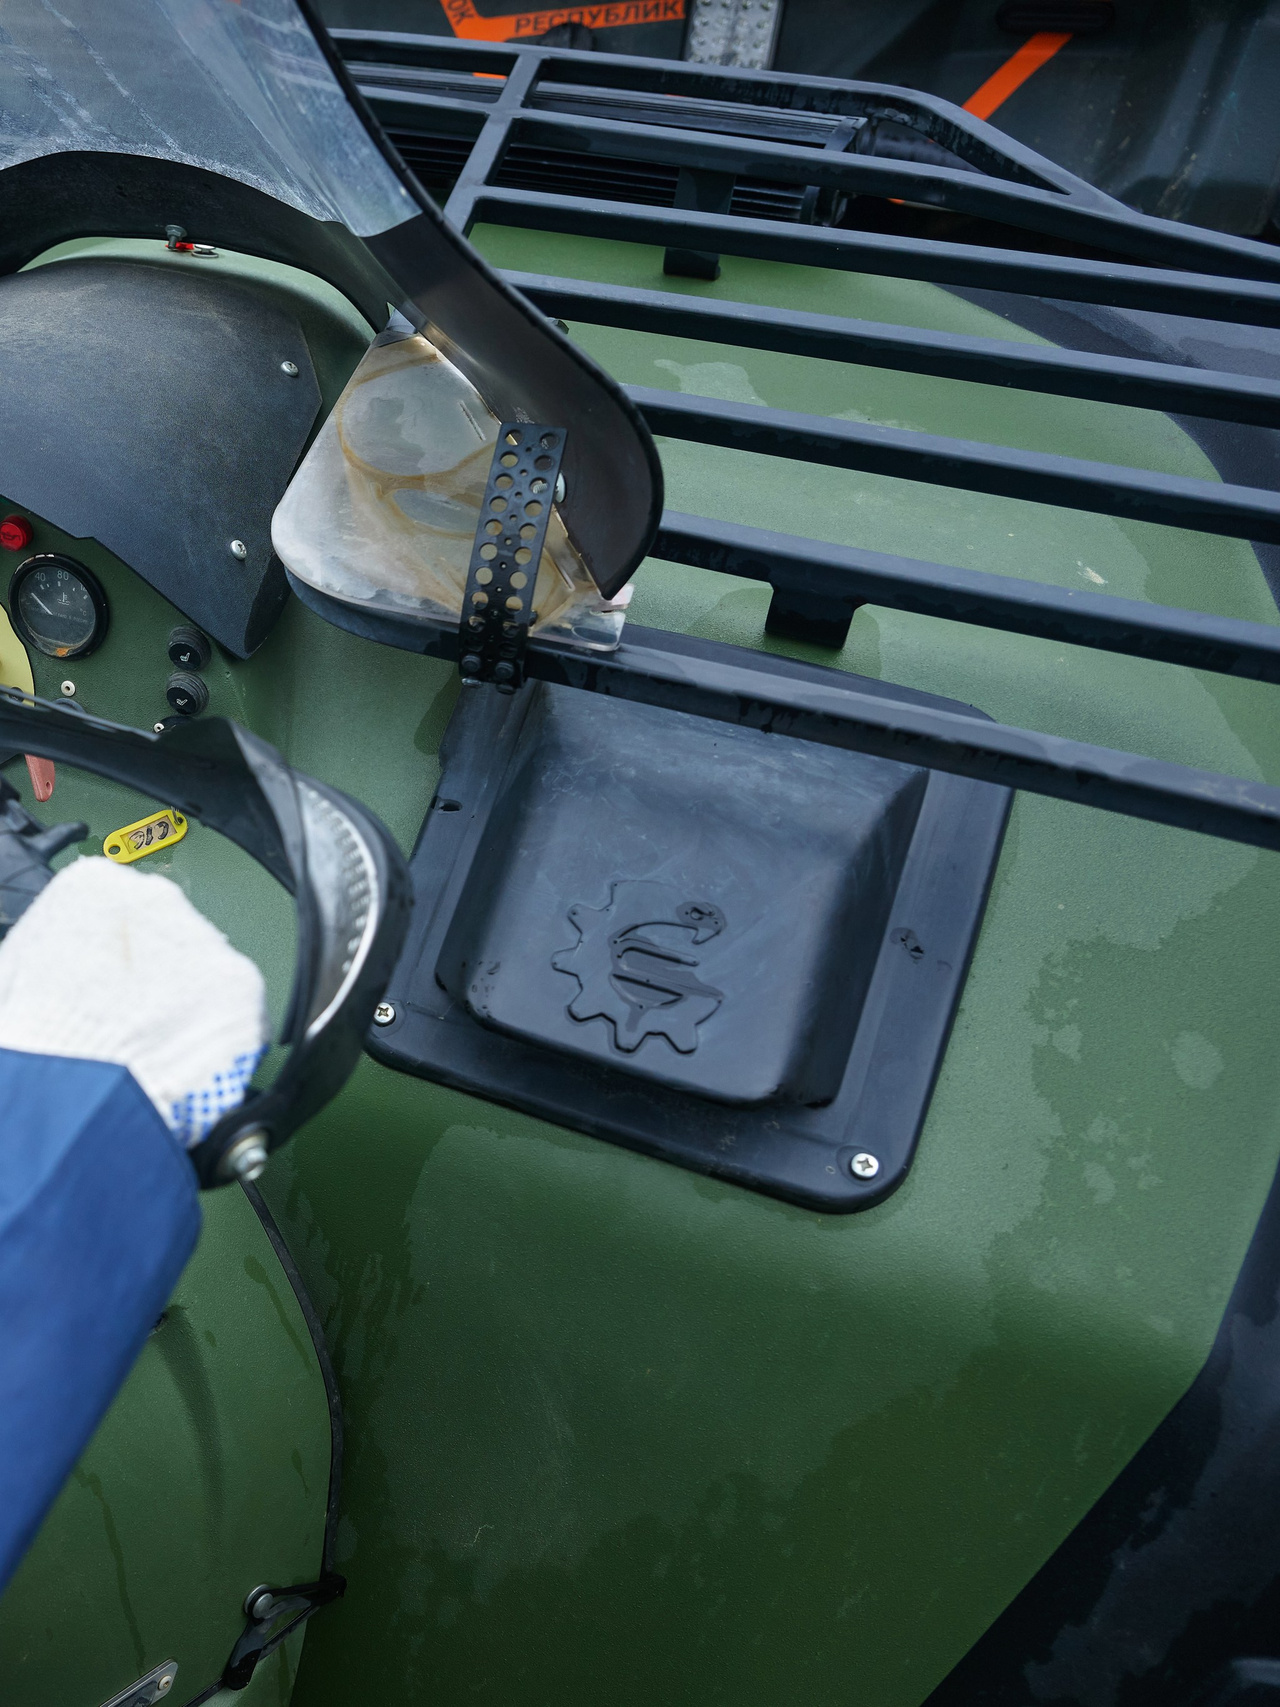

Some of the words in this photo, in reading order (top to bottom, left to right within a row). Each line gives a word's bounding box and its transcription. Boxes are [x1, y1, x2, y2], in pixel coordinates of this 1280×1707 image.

[514, 1, 679, 33] РЕСПУБЛИК
[34, 572, 47, 582] 40
[56, 570, 69, 581] 80
